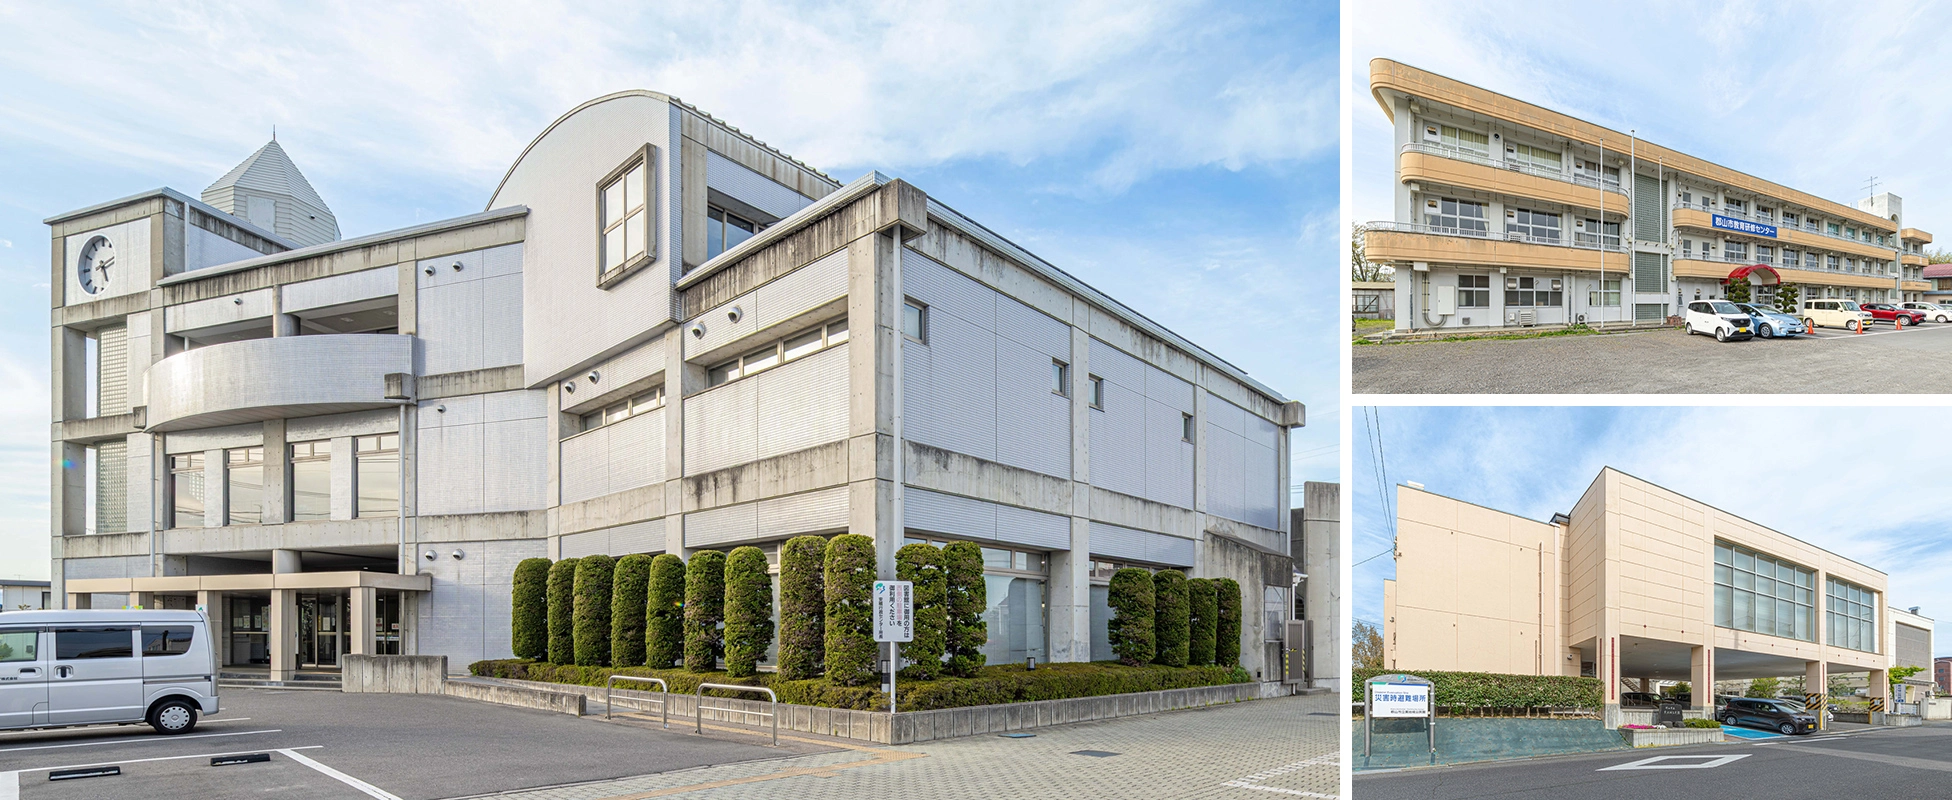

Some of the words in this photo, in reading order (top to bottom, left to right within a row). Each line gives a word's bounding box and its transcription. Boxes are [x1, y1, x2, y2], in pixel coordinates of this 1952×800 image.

[1715, 217, 1775, 234] 郡山市教育研修センター
[1375, 694, 1426, 702] 災害時避難場所
